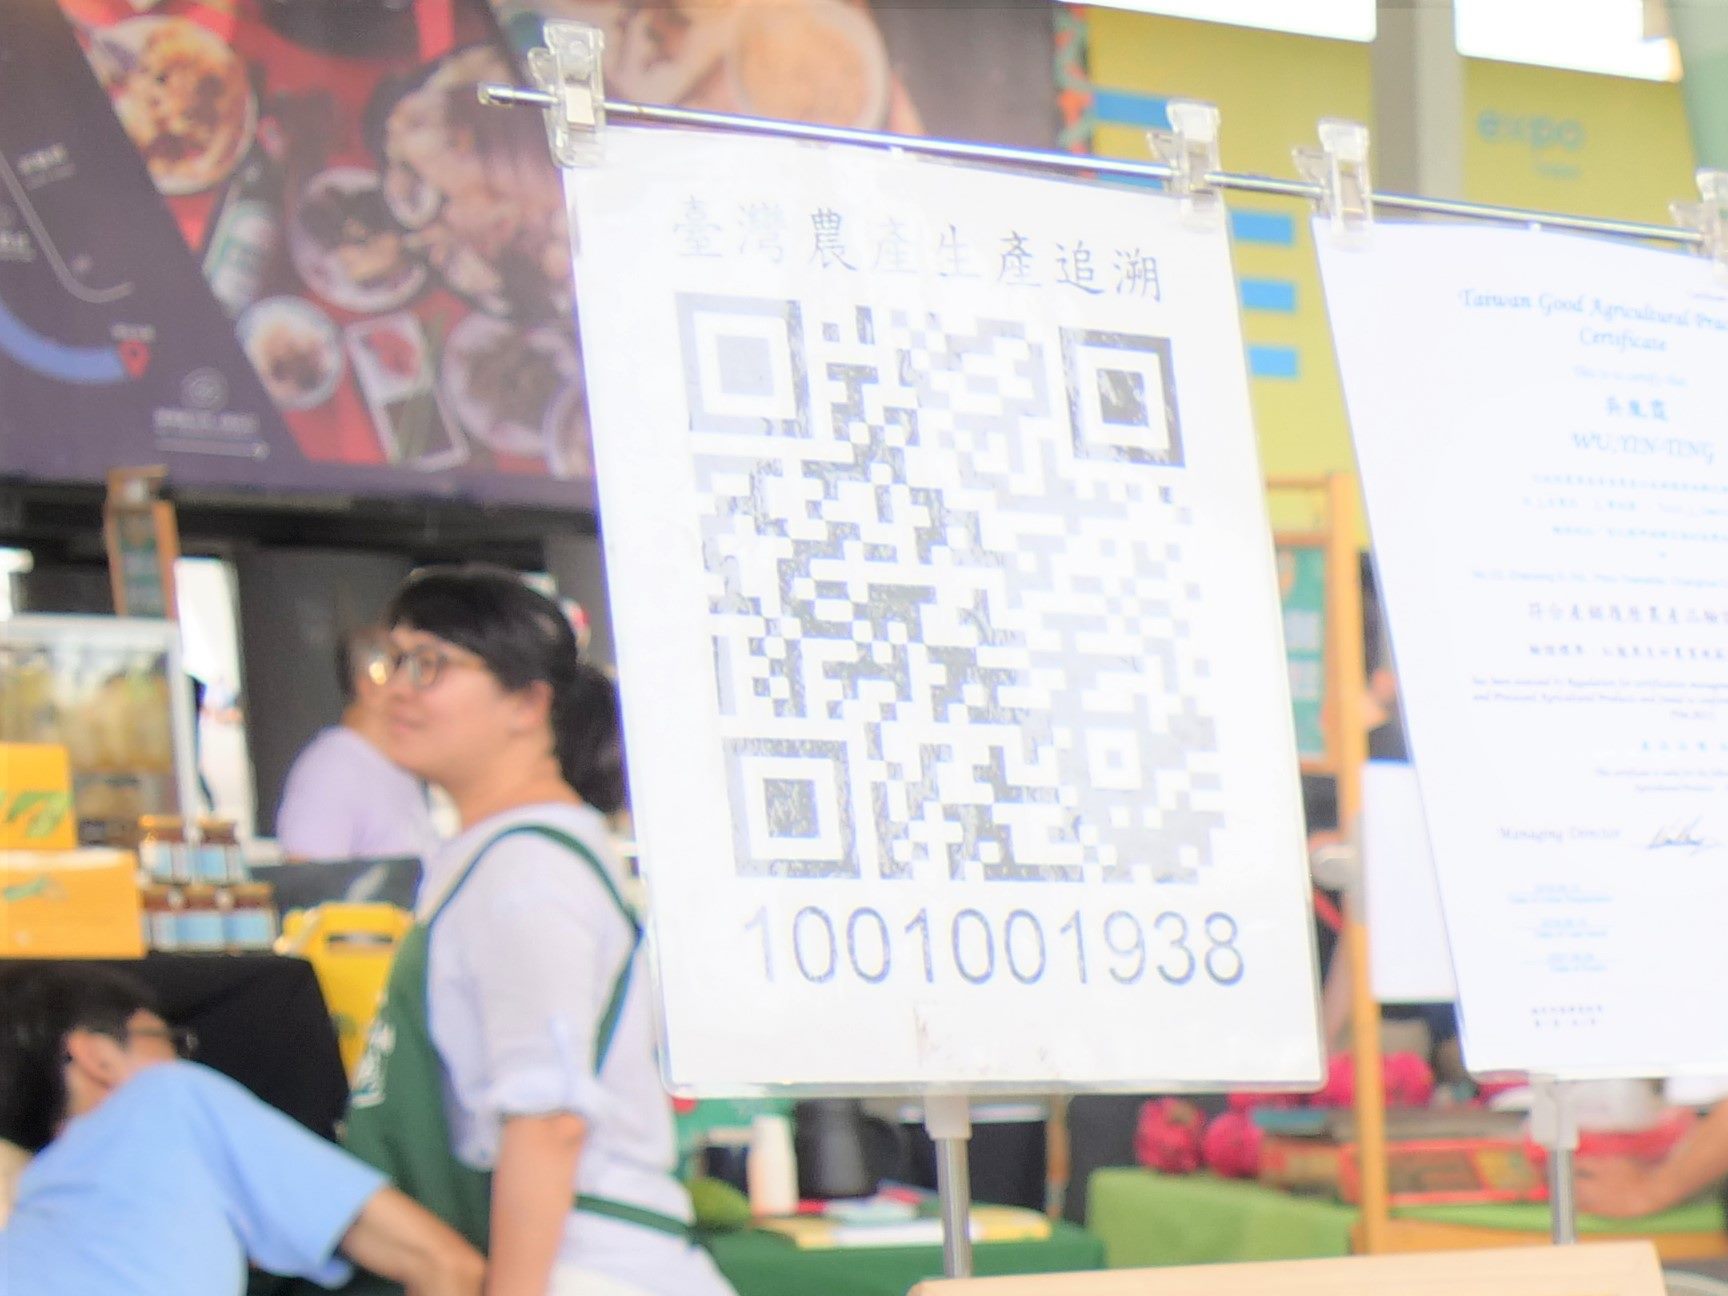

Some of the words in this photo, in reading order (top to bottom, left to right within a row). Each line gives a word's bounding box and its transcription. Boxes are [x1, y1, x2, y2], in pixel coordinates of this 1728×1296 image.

[672, 194, 1163, 303] 臺灣農產生產追溯
[1459, 288, 1532, 310] Taiwan
[1537, 293, 1584, 318] Good
[1591, 298, 1690, 329] Agricultural
[1578, 326, 1669, 352] Certificate
[743, 904, 1245, 987] 1001001938
